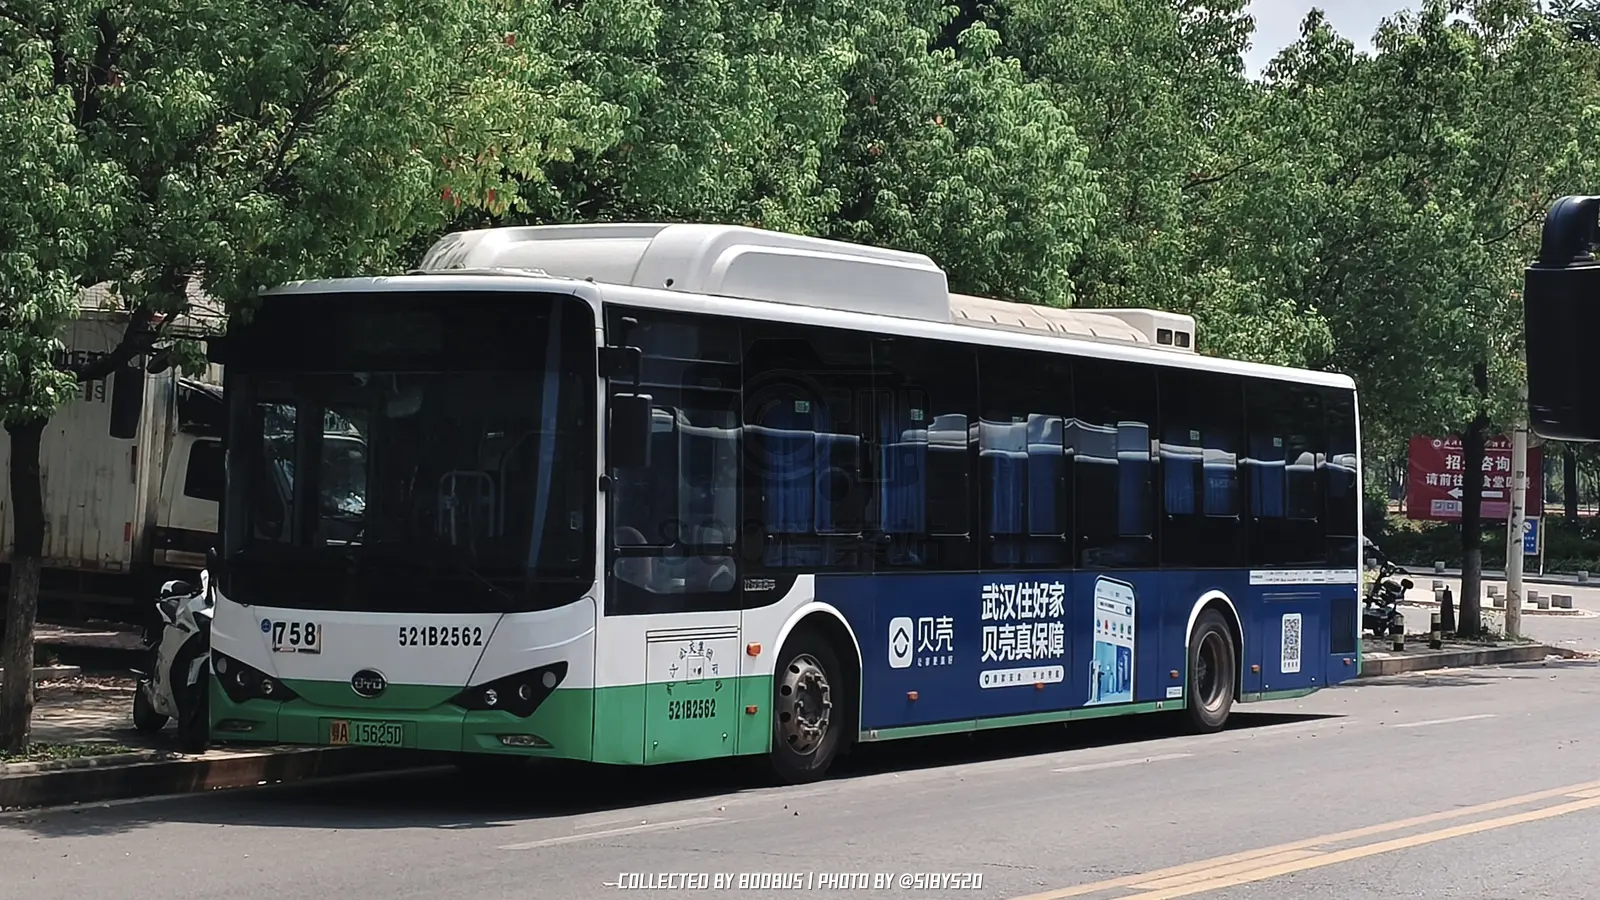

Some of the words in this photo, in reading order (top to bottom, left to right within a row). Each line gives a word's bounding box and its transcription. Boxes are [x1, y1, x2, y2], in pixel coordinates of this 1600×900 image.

[1445, 454, 1510, 472] 招咨询
[981, 581, 1065, 621] 武汉住好家
[274, 621, 316, 646] 758
[399, 626, 483, 647] 521B2562
[917, 615, 954, 653] 贝壳
[981, 621, 1065, 663] 贝壳真保障
[668, 699, 716, 720] 521B2562
